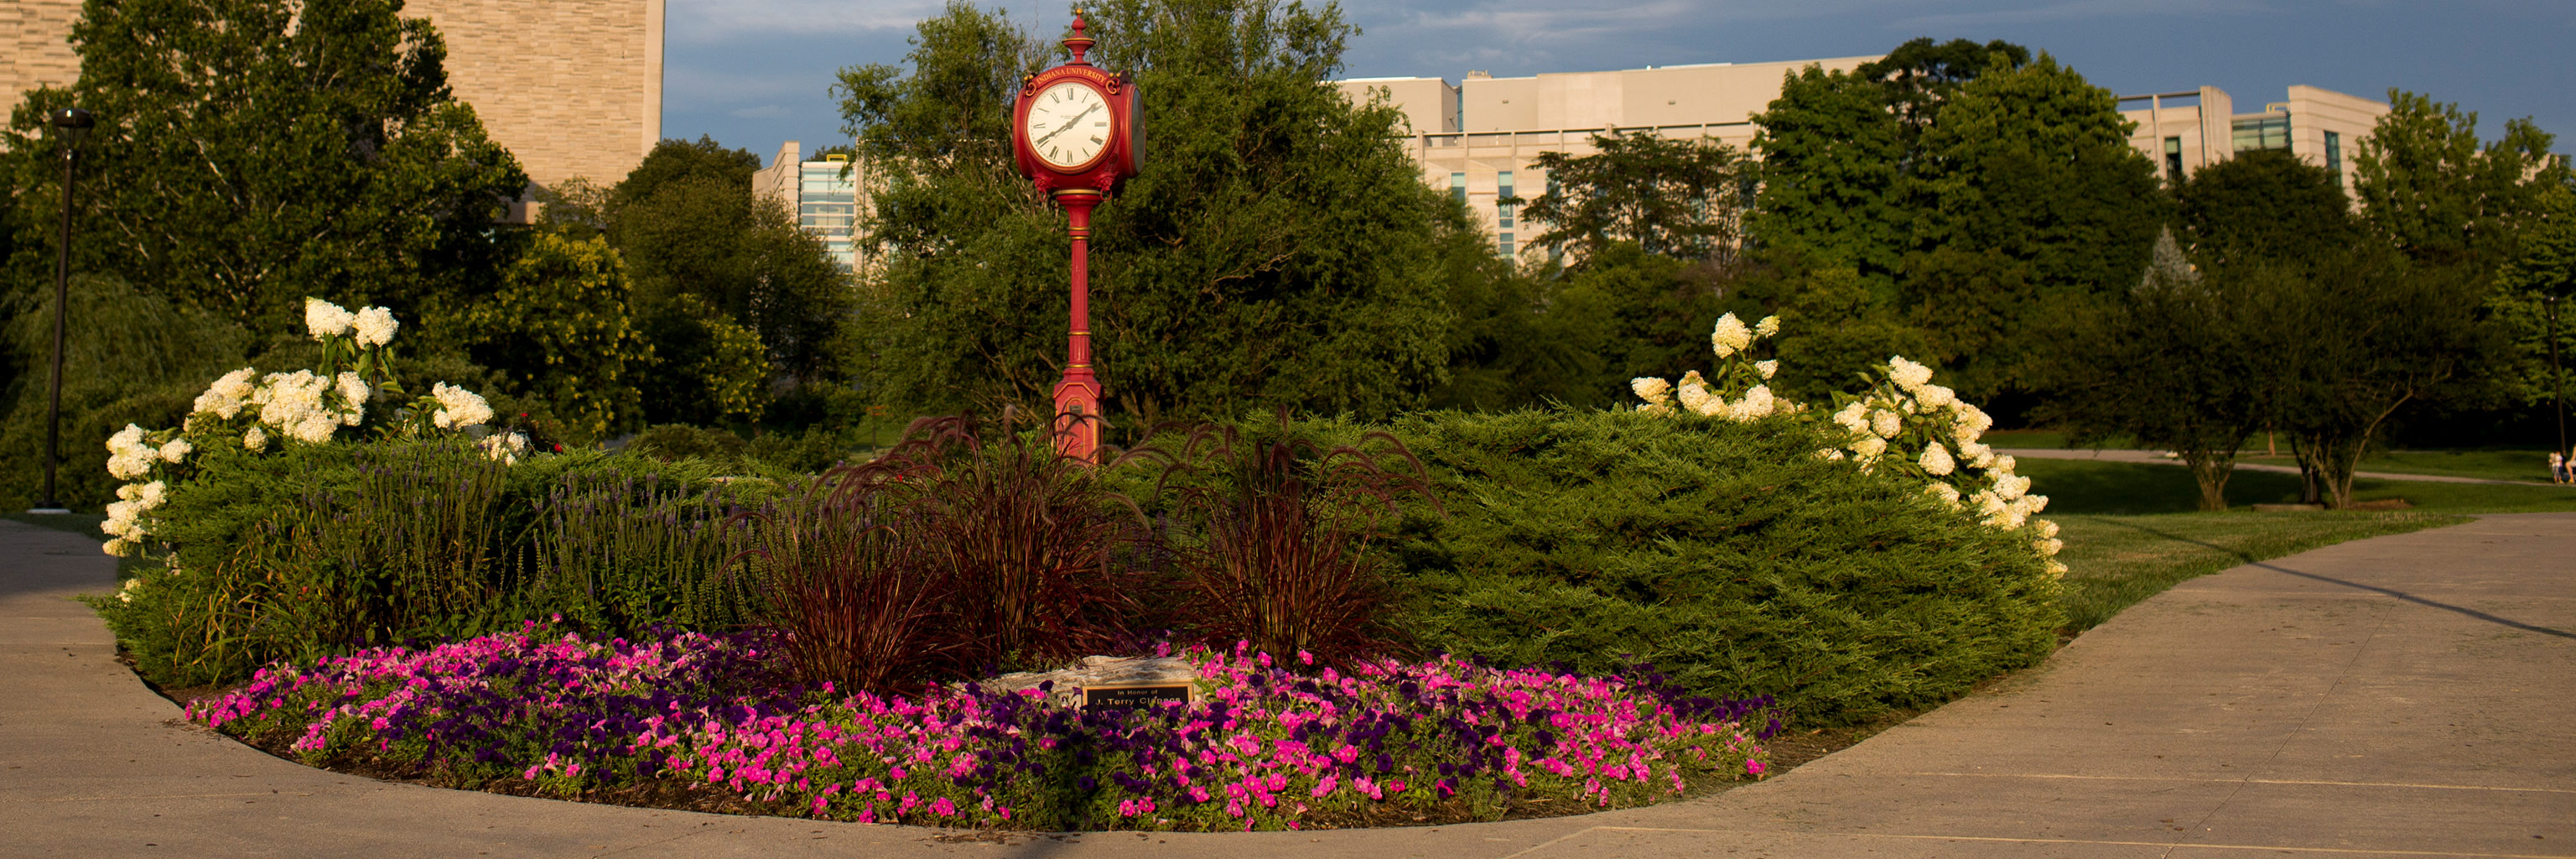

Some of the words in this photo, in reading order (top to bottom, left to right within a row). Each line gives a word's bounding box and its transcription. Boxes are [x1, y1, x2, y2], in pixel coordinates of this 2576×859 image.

[1036, 68, 1066, 85] INDIANA
[1066, 67, 1107, 83] UNIVERSITY
[1107, 698, 1135, 706] Terry
